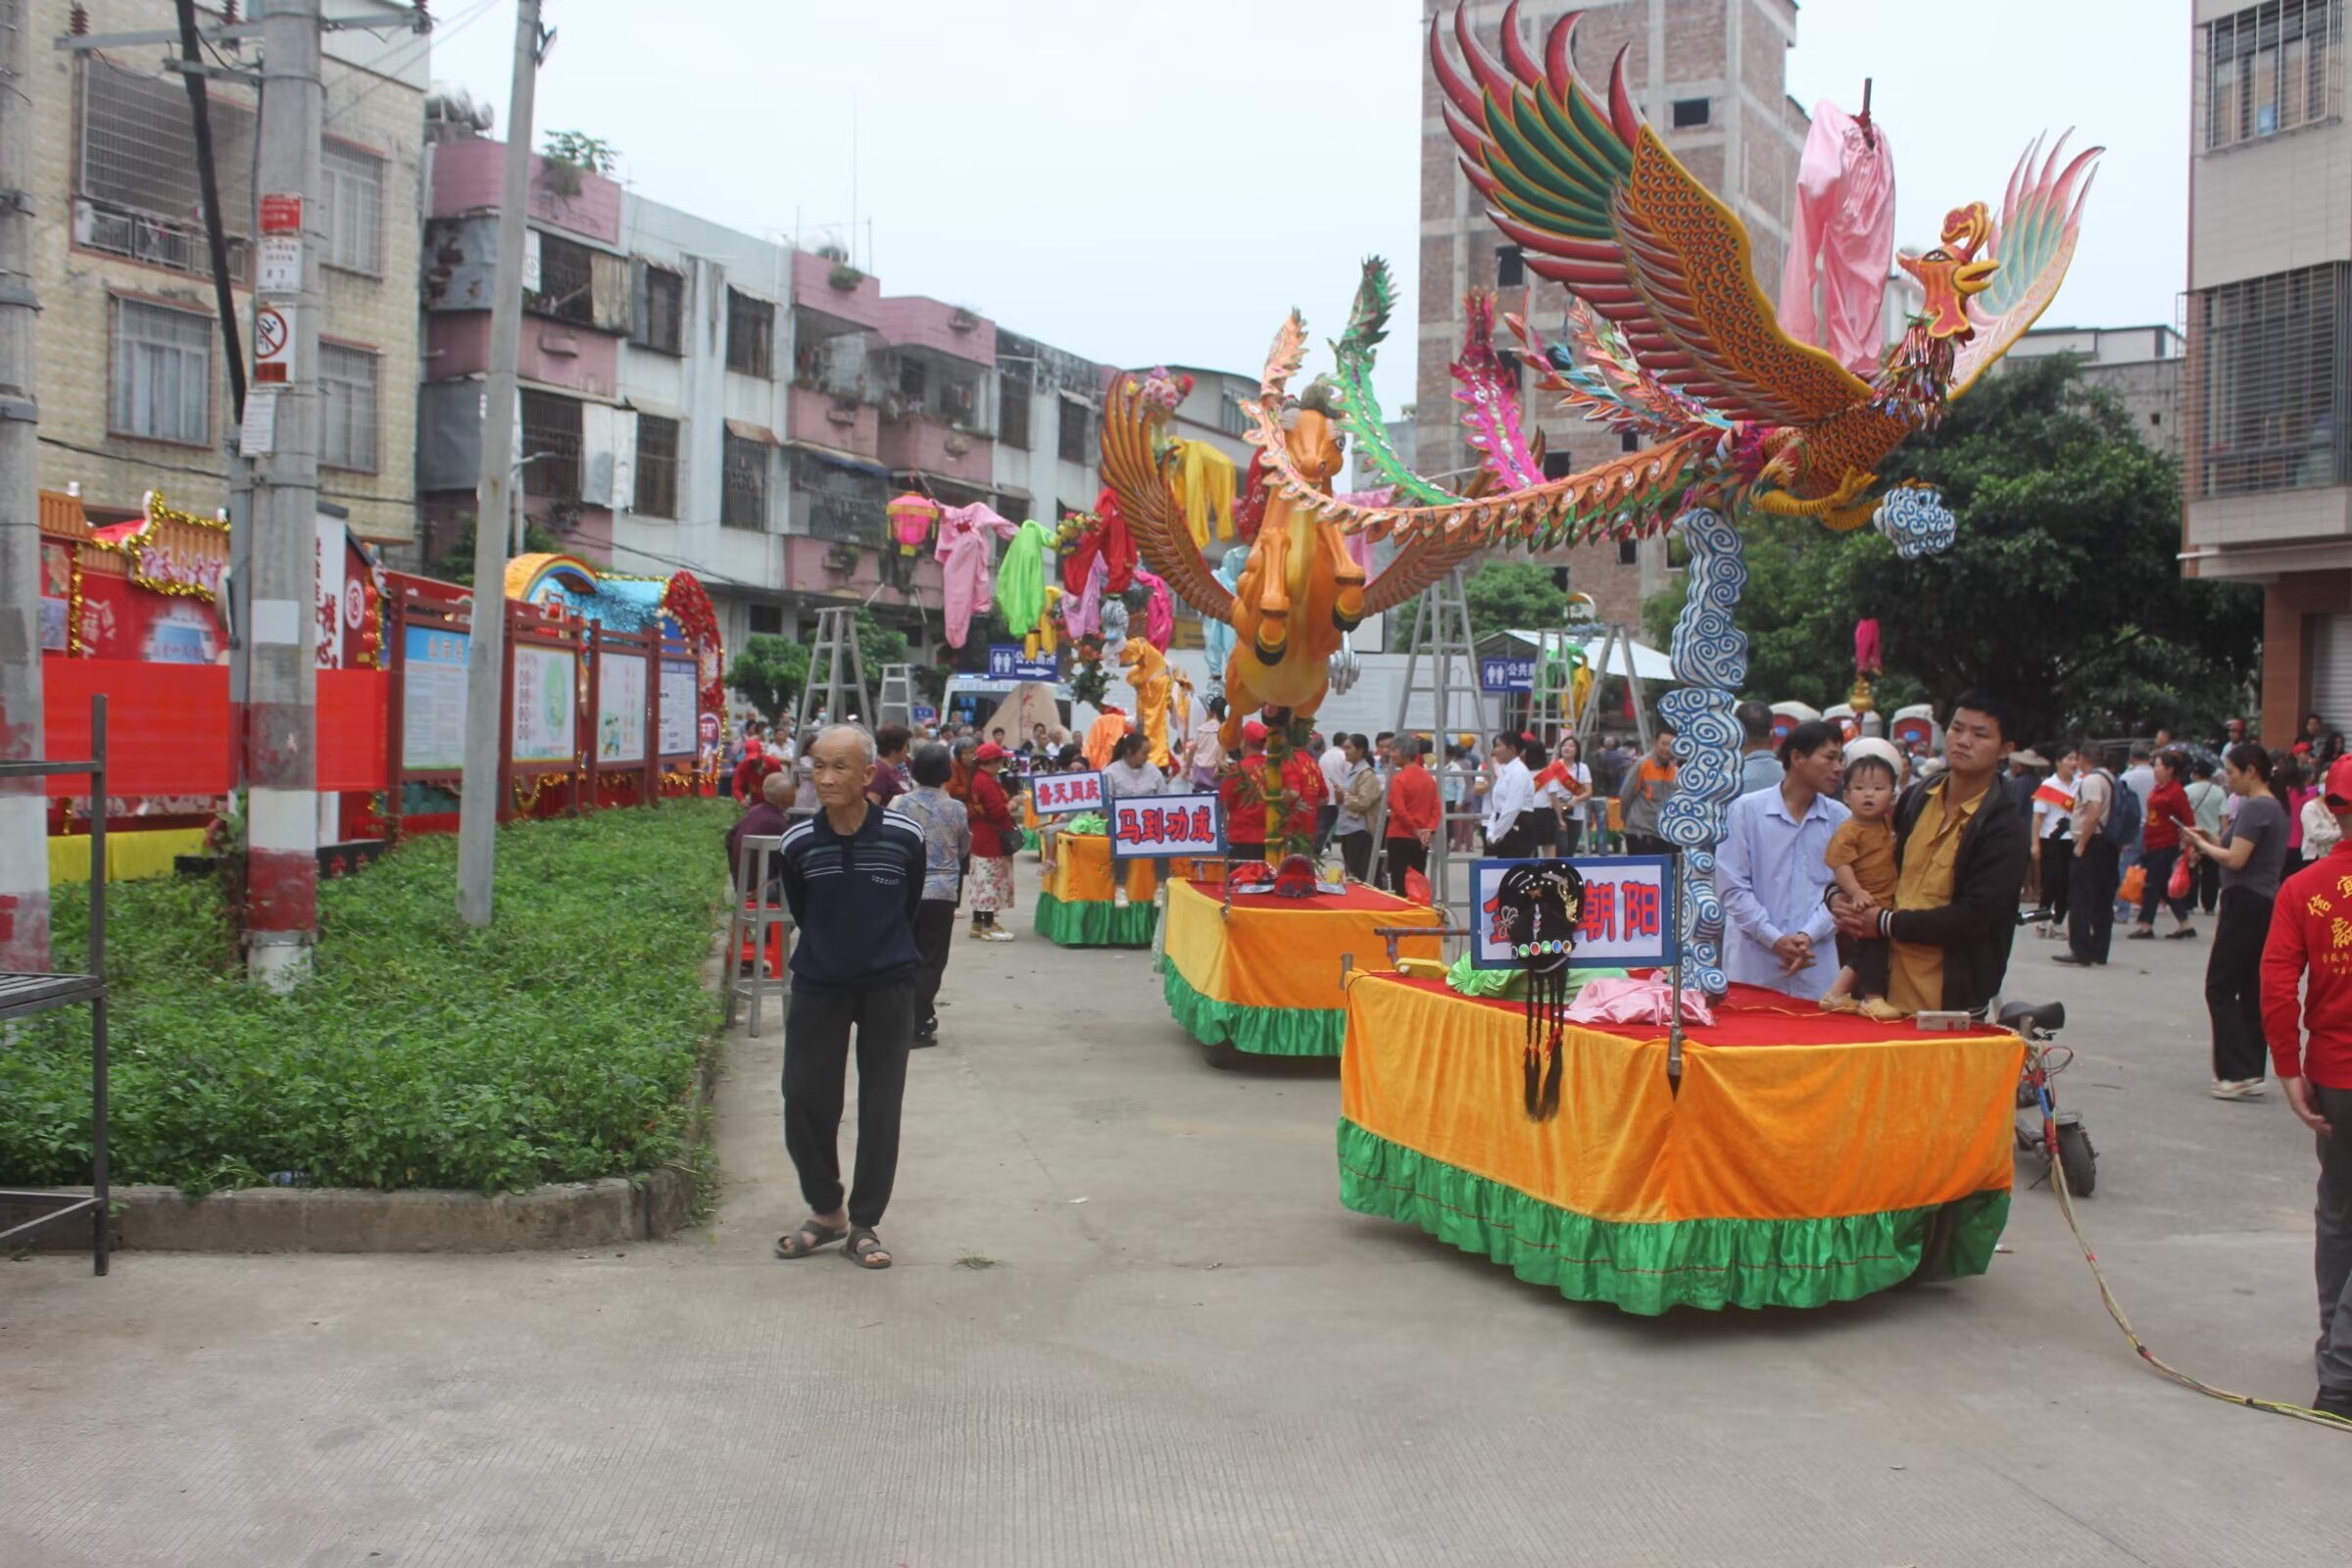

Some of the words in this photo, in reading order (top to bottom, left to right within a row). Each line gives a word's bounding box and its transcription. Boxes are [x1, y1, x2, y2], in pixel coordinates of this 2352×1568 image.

[1116, 805, 1215, 845] 马到功成
[1483, 879, 1660, 945] 朝阳
